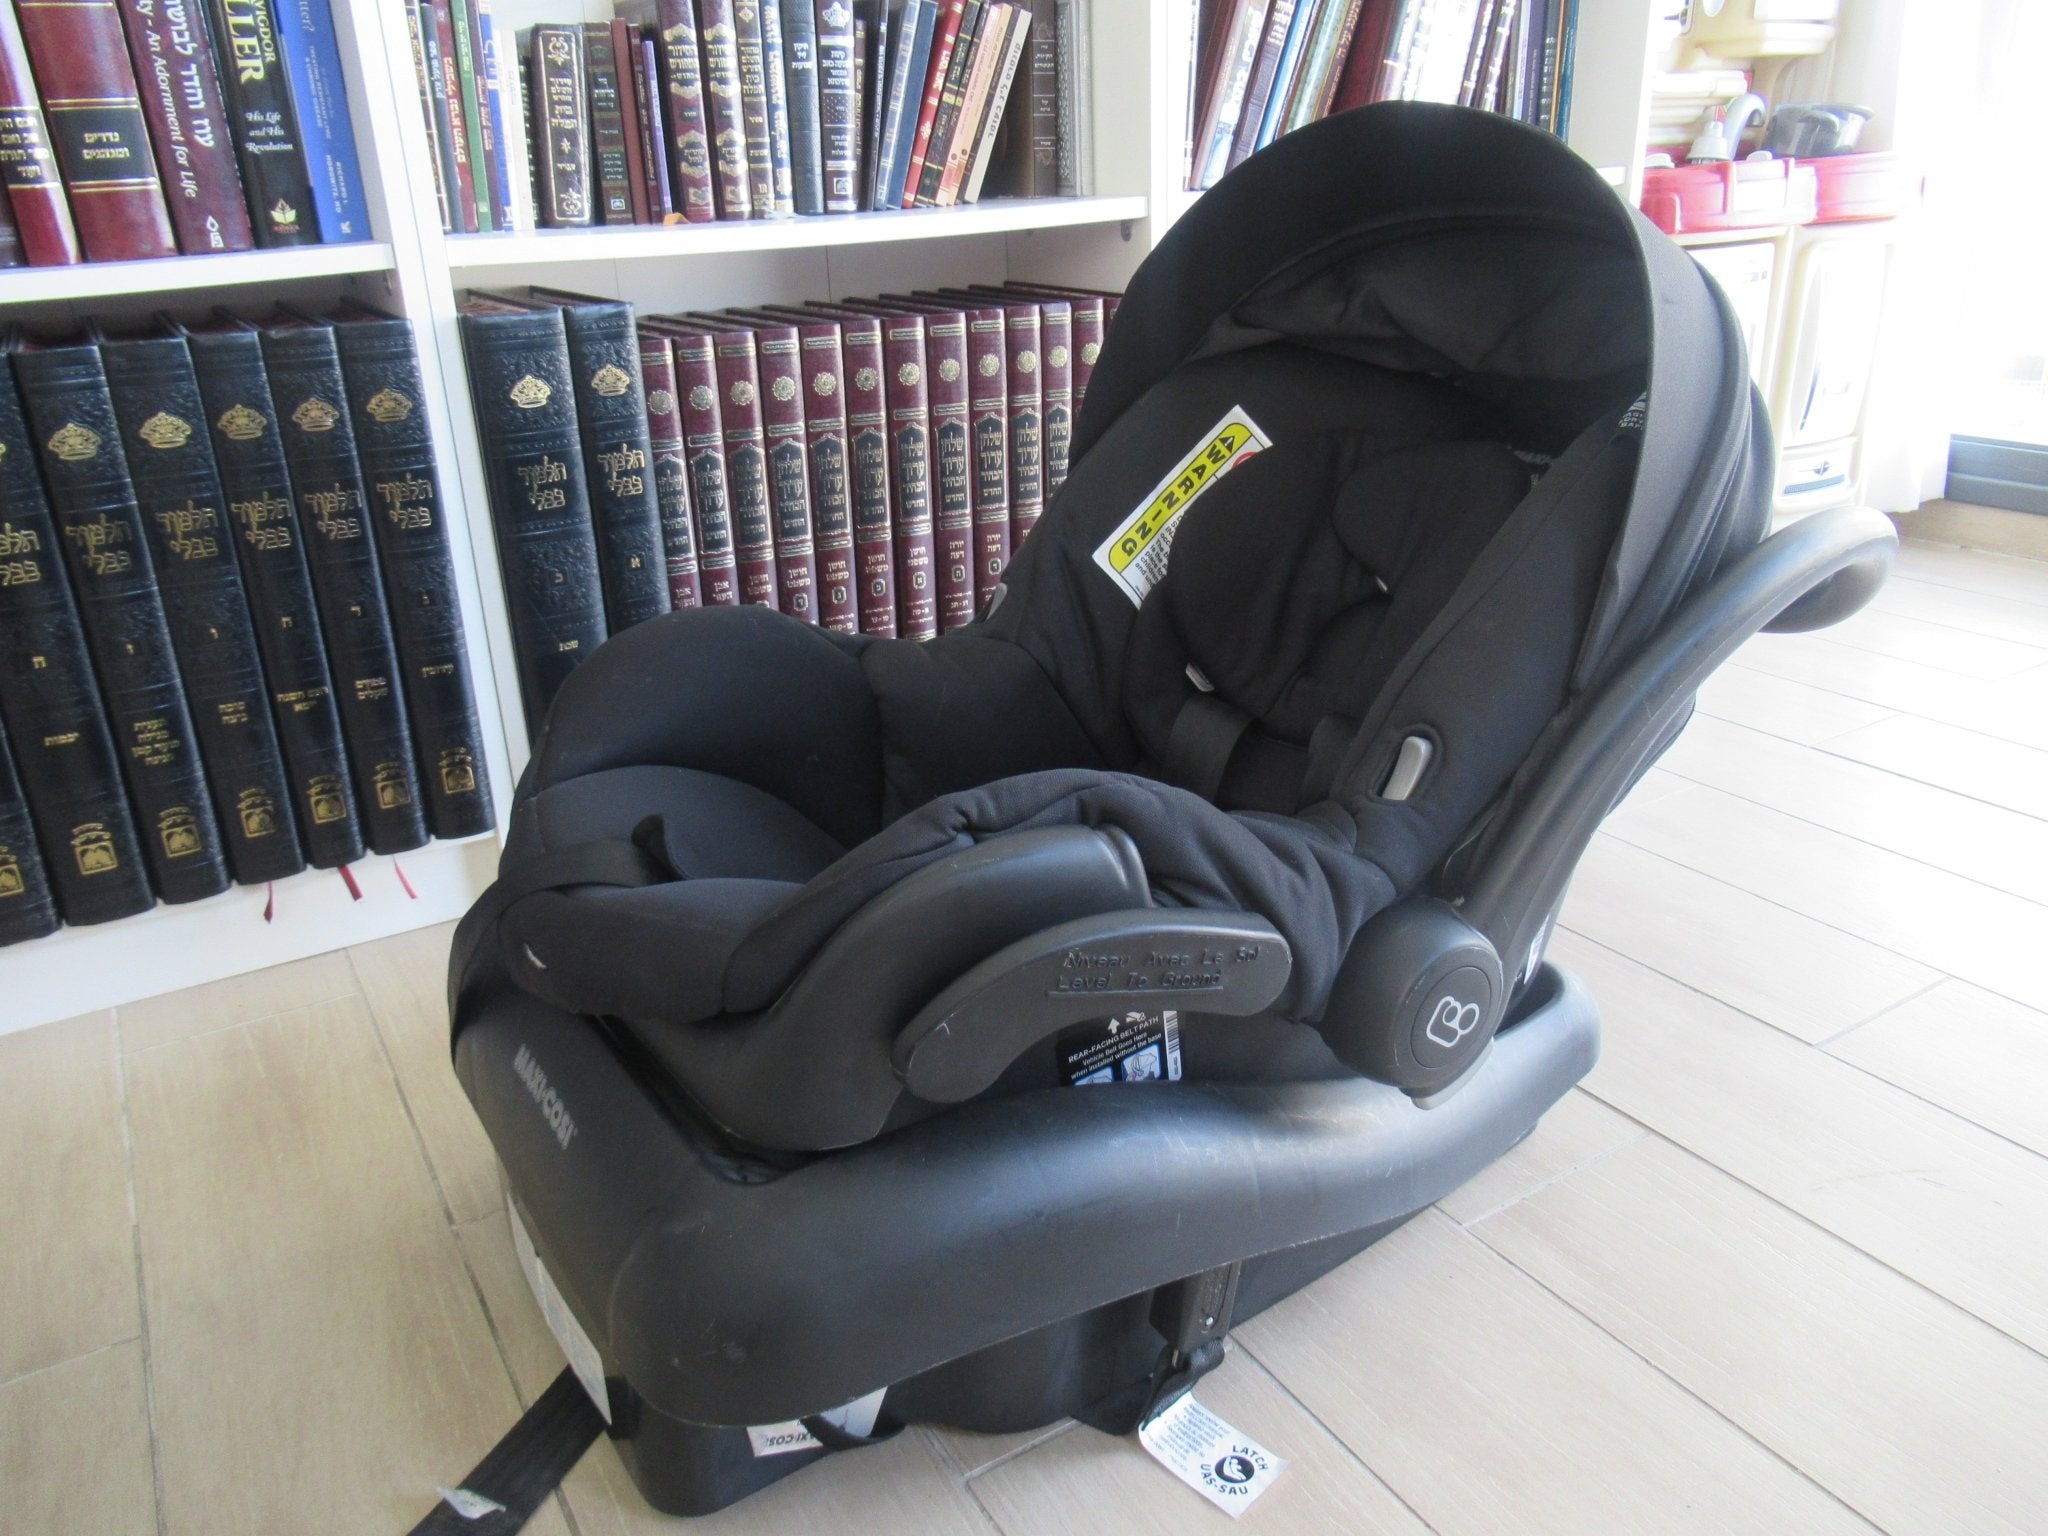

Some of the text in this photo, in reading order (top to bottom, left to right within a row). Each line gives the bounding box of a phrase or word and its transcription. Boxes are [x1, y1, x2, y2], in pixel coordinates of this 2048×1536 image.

[147, 30, 161, 52] An
[1006, 43, 1021, 80] קונטרס
[152, 54, 185, 142] Adornment
[180, 62, 215, 147] עוז והדר
[444, 57, 466, 163] בשבילי נברא העולם
[246, 111, 282, 122] His Life
[988, 105, 1003, 138] בעומר
[249, 127, 267, 137] and
[171, 144, 188, 168] for
[246, 142, 294, 154] Revolution
[180, 169, 197, 198] Life
[941, 432, 964, 456] שלחן
[979, 427, 1002, 450] שלחן
[1017, 422, 1039, 446] שלחן
[597, 443, 645, 473] תלמוד
[942, 456, 965, 474] ערוך
[980, 451, 1002, 470] ערוך
[1017, 446, 1038, 464] ערוך
[518, 455, 567, 486] תלמוד
[903, 460, 925, 480] ערוך
[376, 472, 434, 503] תלמוד
[528, 483, 566, 511] בבלי
[607, 471, 643, 497] בבלי
[231, 491, 291, 523] תלמוד
[304, 483, 362, 514] תלמוד
[1121, 443, 1227, 557] WARNING
[155, 500, 219, 533] תלמוד
[317, 512, 361, 540] בבלי
[389, 502, 432, 529] בבלי
[64, 513, 132, 547] תלמוד
[246, 521, 292, 550] בבלי
[986, 534, 1001, 542] יורה
[170, 531, 219, 559] בבלי
[910, 546, 926, 557] חושן
[949, 540, 964, 549] יורה
[950, 551, 965, 560] דעה
[987, 544, 1001, 553] דעה
[82, 546, 132, 575] בבלי
[828, 560, 846, 572] חושן
[867, 554, 886, 565] חושן
[713, 580, 730, 591] אבן
[788, 567, 808, 580] חושן
[1202, 948, 1225, 965] Le
[1058, 969, 1222, 990] Level To Ground
[1068, 1016, 1159, 1064] REAR-FACING BELT PATH
[1082, 1053, 1104, 1067] Vehicle
[1105, 1046, 1117, 1056] Belt
[1133, 1031, 1148, 1043] Here
[1070, 1033, 1162, 1080] when installed without the base
[1232, 1444, 1269, 1471] LATCH
[1201, 1463, 1249, 1496] UAS-SAU
